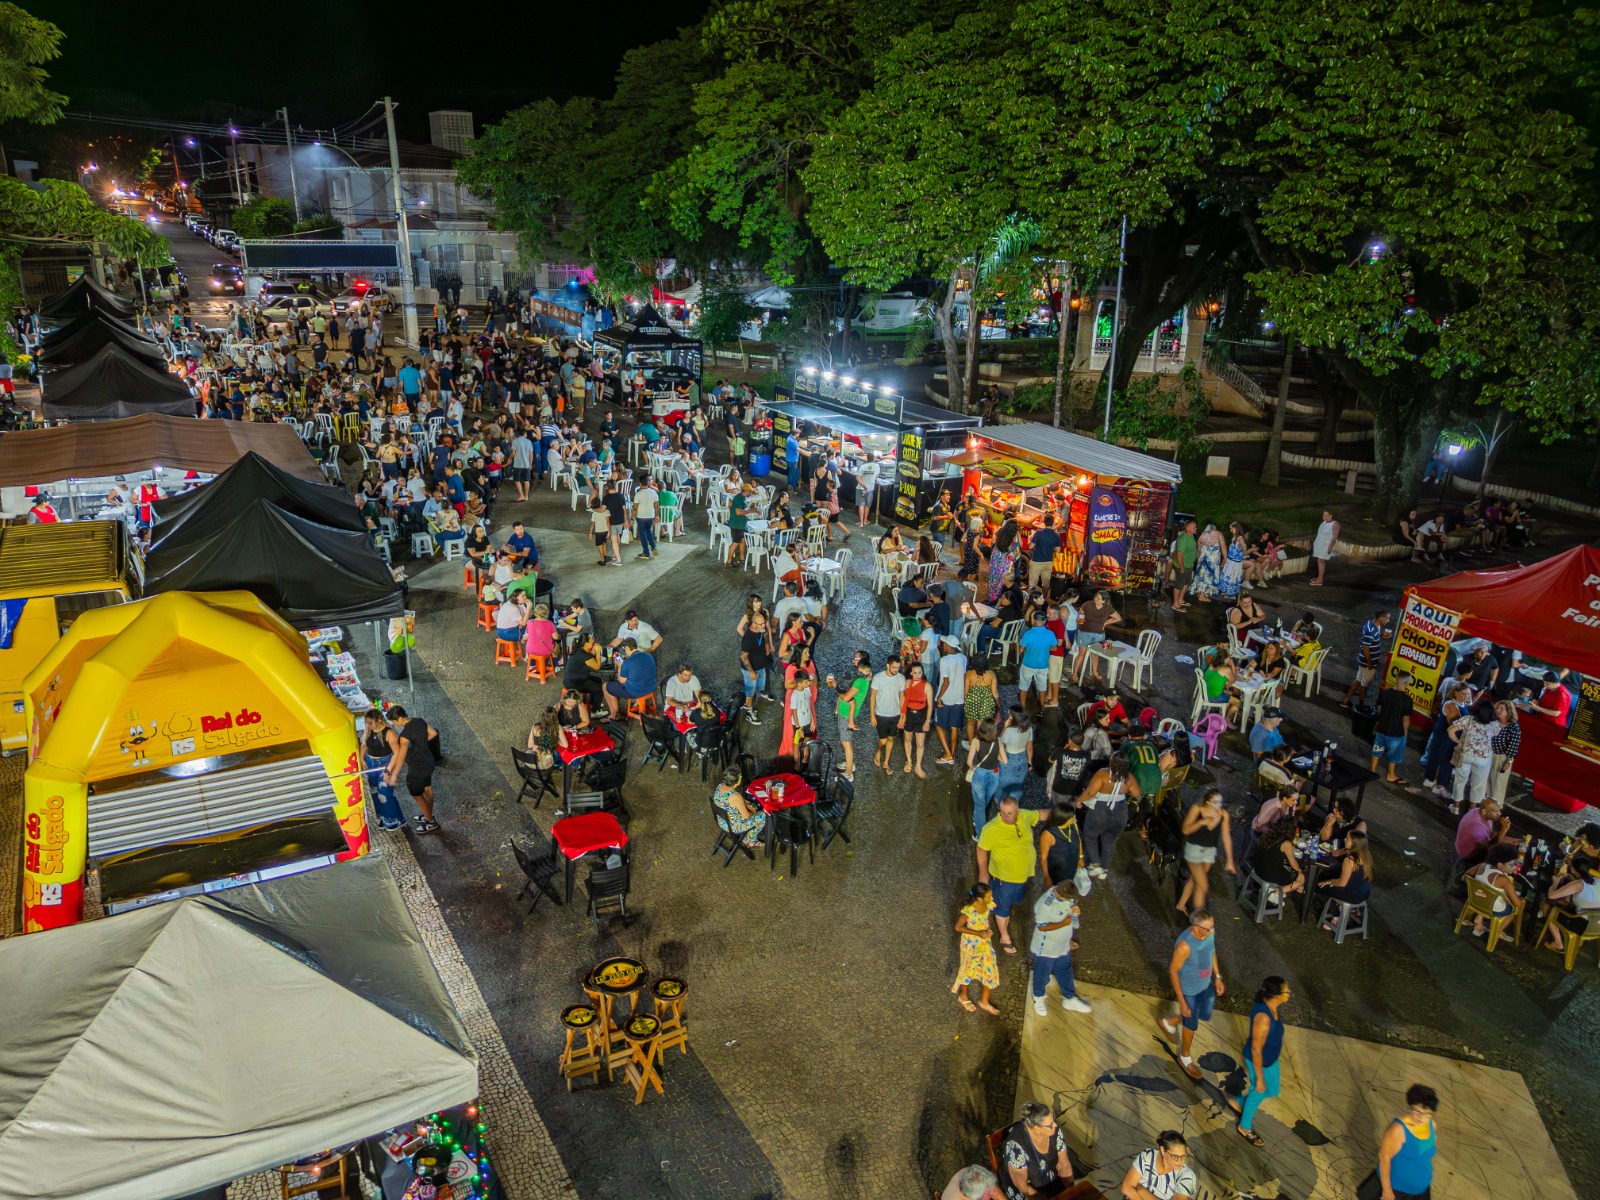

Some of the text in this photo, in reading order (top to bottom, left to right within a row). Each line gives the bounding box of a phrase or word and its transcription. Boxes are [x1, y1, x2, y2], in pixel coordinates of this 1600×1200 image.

[1412, 602, 1453, 626] AQUI
[1561, 607, 1600, 628] Feir
[1402, 628, 1445, 655] CHOPP
[1400, 645, 1437, 668] BRAHMA
[1391, 666, 1433, 694] COPP
[1410, 665, 1417, 674] E
[201, 708, 262, 733] Rei do
[171, 737, 196, 756] RS
[203, 722, 282, 750] Salgado
[343, 752, 359, 775] do
[1135, 745, 1156, 764] 10
[26, 812, 41, 873] Rei do
[40, 795, 70, 875] Salgado
[41, 882, 63, 906] RS
